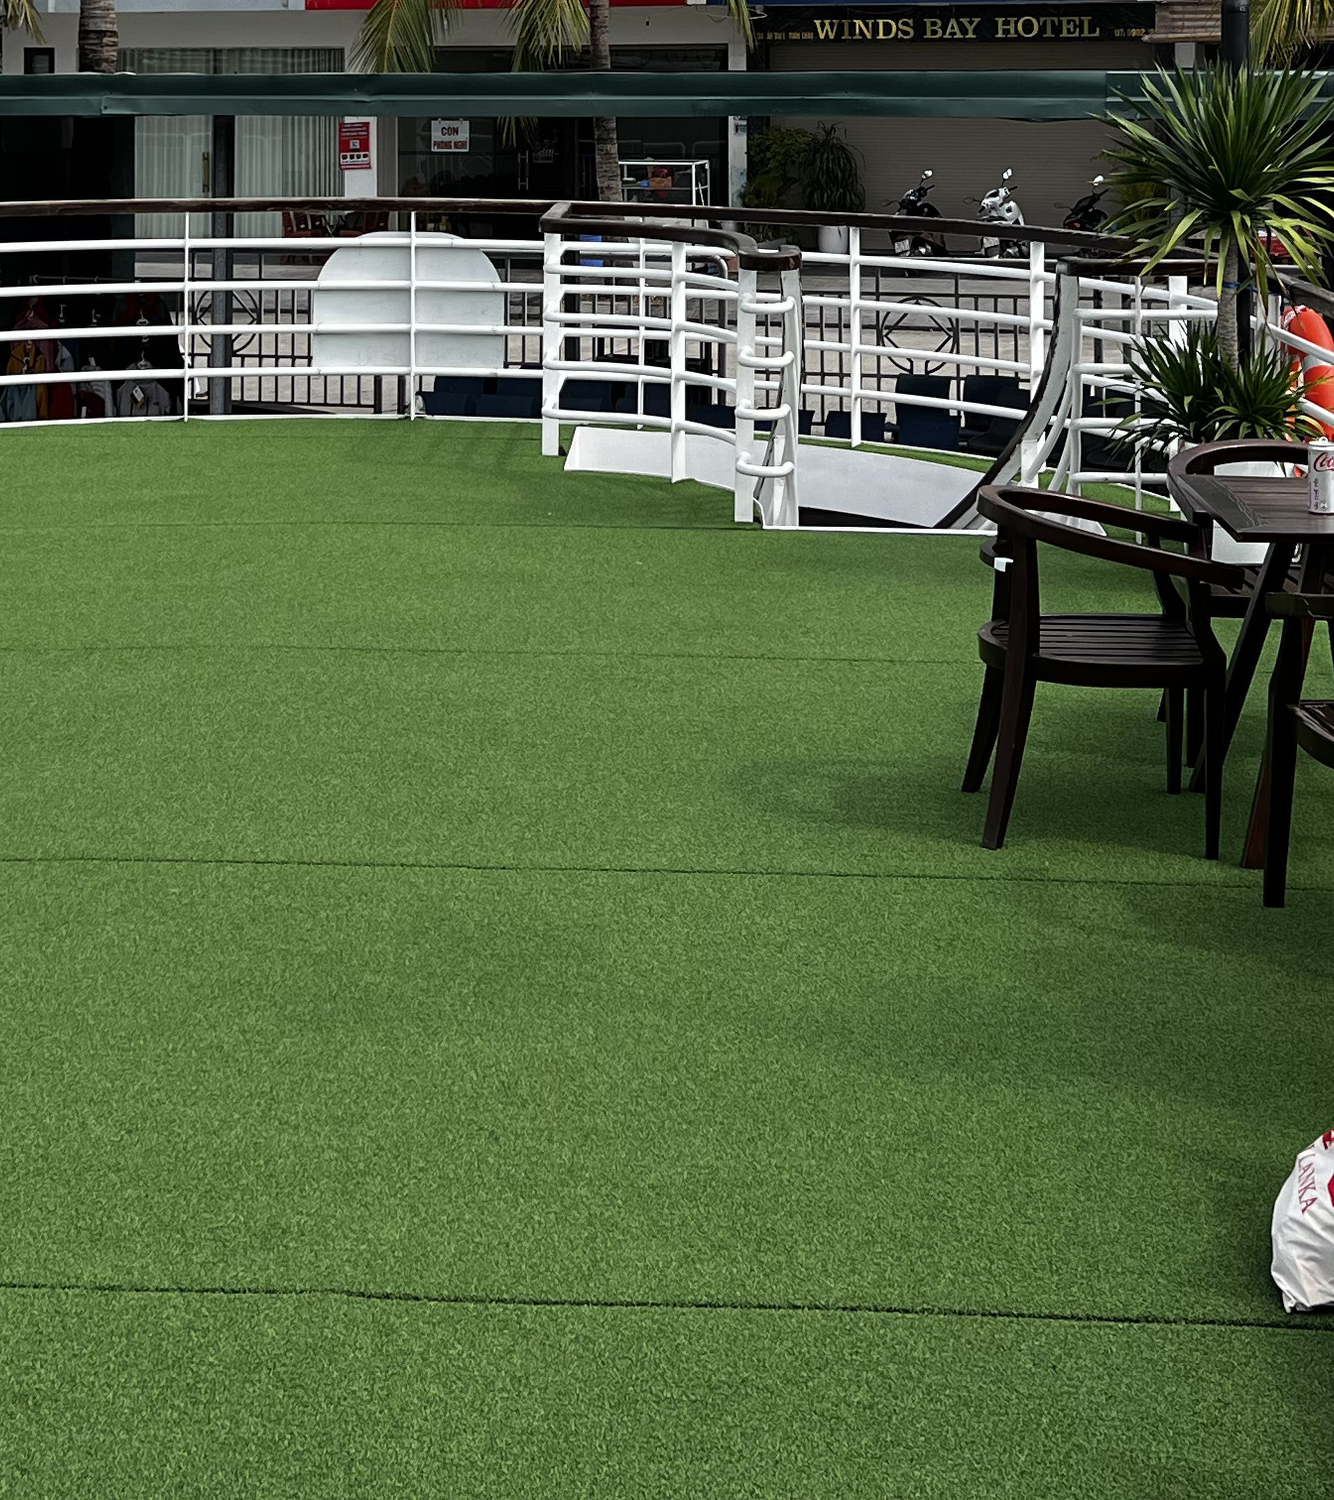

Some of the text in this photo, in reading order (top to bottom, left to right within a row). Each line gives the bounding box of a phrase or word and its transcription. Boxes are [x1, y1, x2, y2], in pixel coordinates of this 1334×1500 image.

[814, 16, 1100, 40] WINDS BAY HOTEL
[1297, 1152, 1319, 1214] LANKA
